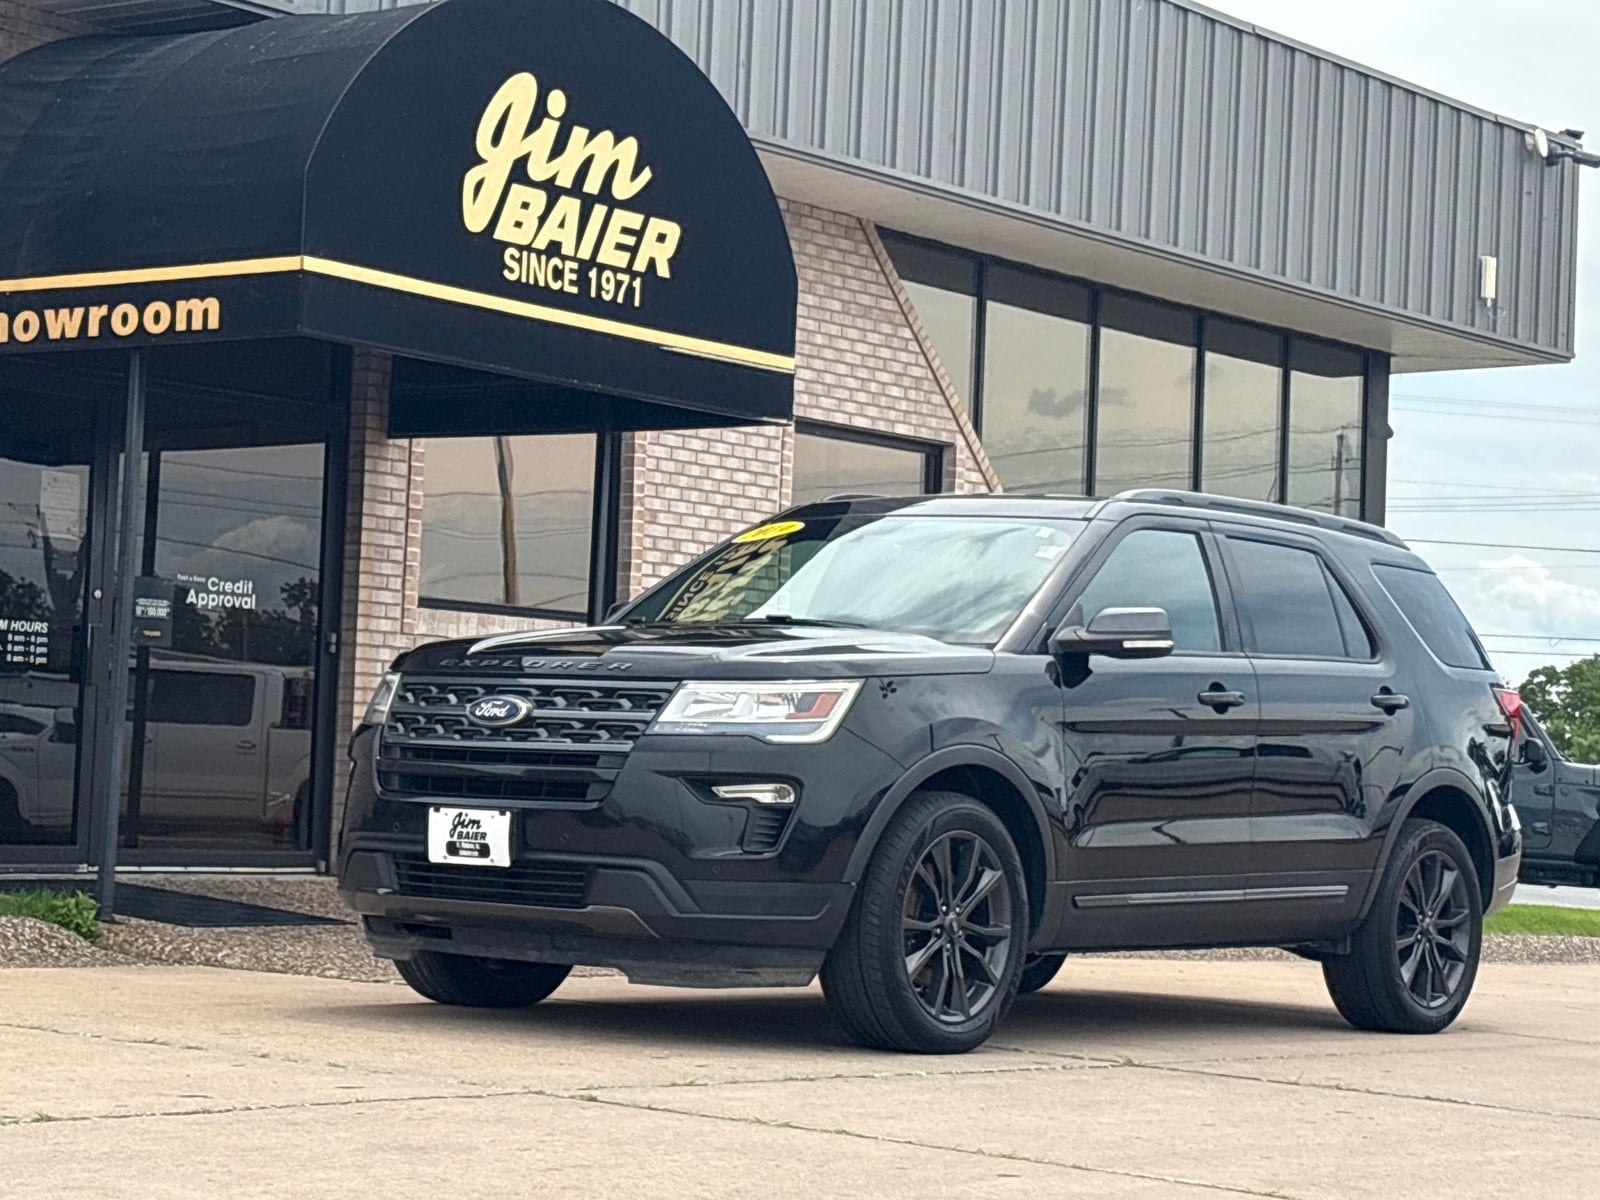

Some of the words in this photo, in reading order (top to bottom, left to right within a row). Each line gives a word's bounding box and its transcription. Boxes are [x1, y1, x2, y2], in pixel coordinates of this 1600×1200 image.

[462, 71, 653, 233] Jim
[493, 183, 681, 279] BAIER
[503, 247, 579, 294] SINCE
[588, 267, 642, 308] 1971
[207, 577, 254, 594] Credit
[185, 588, 257, 610] Approval
[10, 620, 49, 634] HOURS
[36, 636, 49, 644] pm
[36, 646, 48, 654] pm
[35, 656, 48, 665] pm
[439, 658, 634, 672] EXPLORER
[475, 700, 510, 718] Ford
[449, 811, 482, 839] Jim
[456, 830, 488, 841] BAIER
